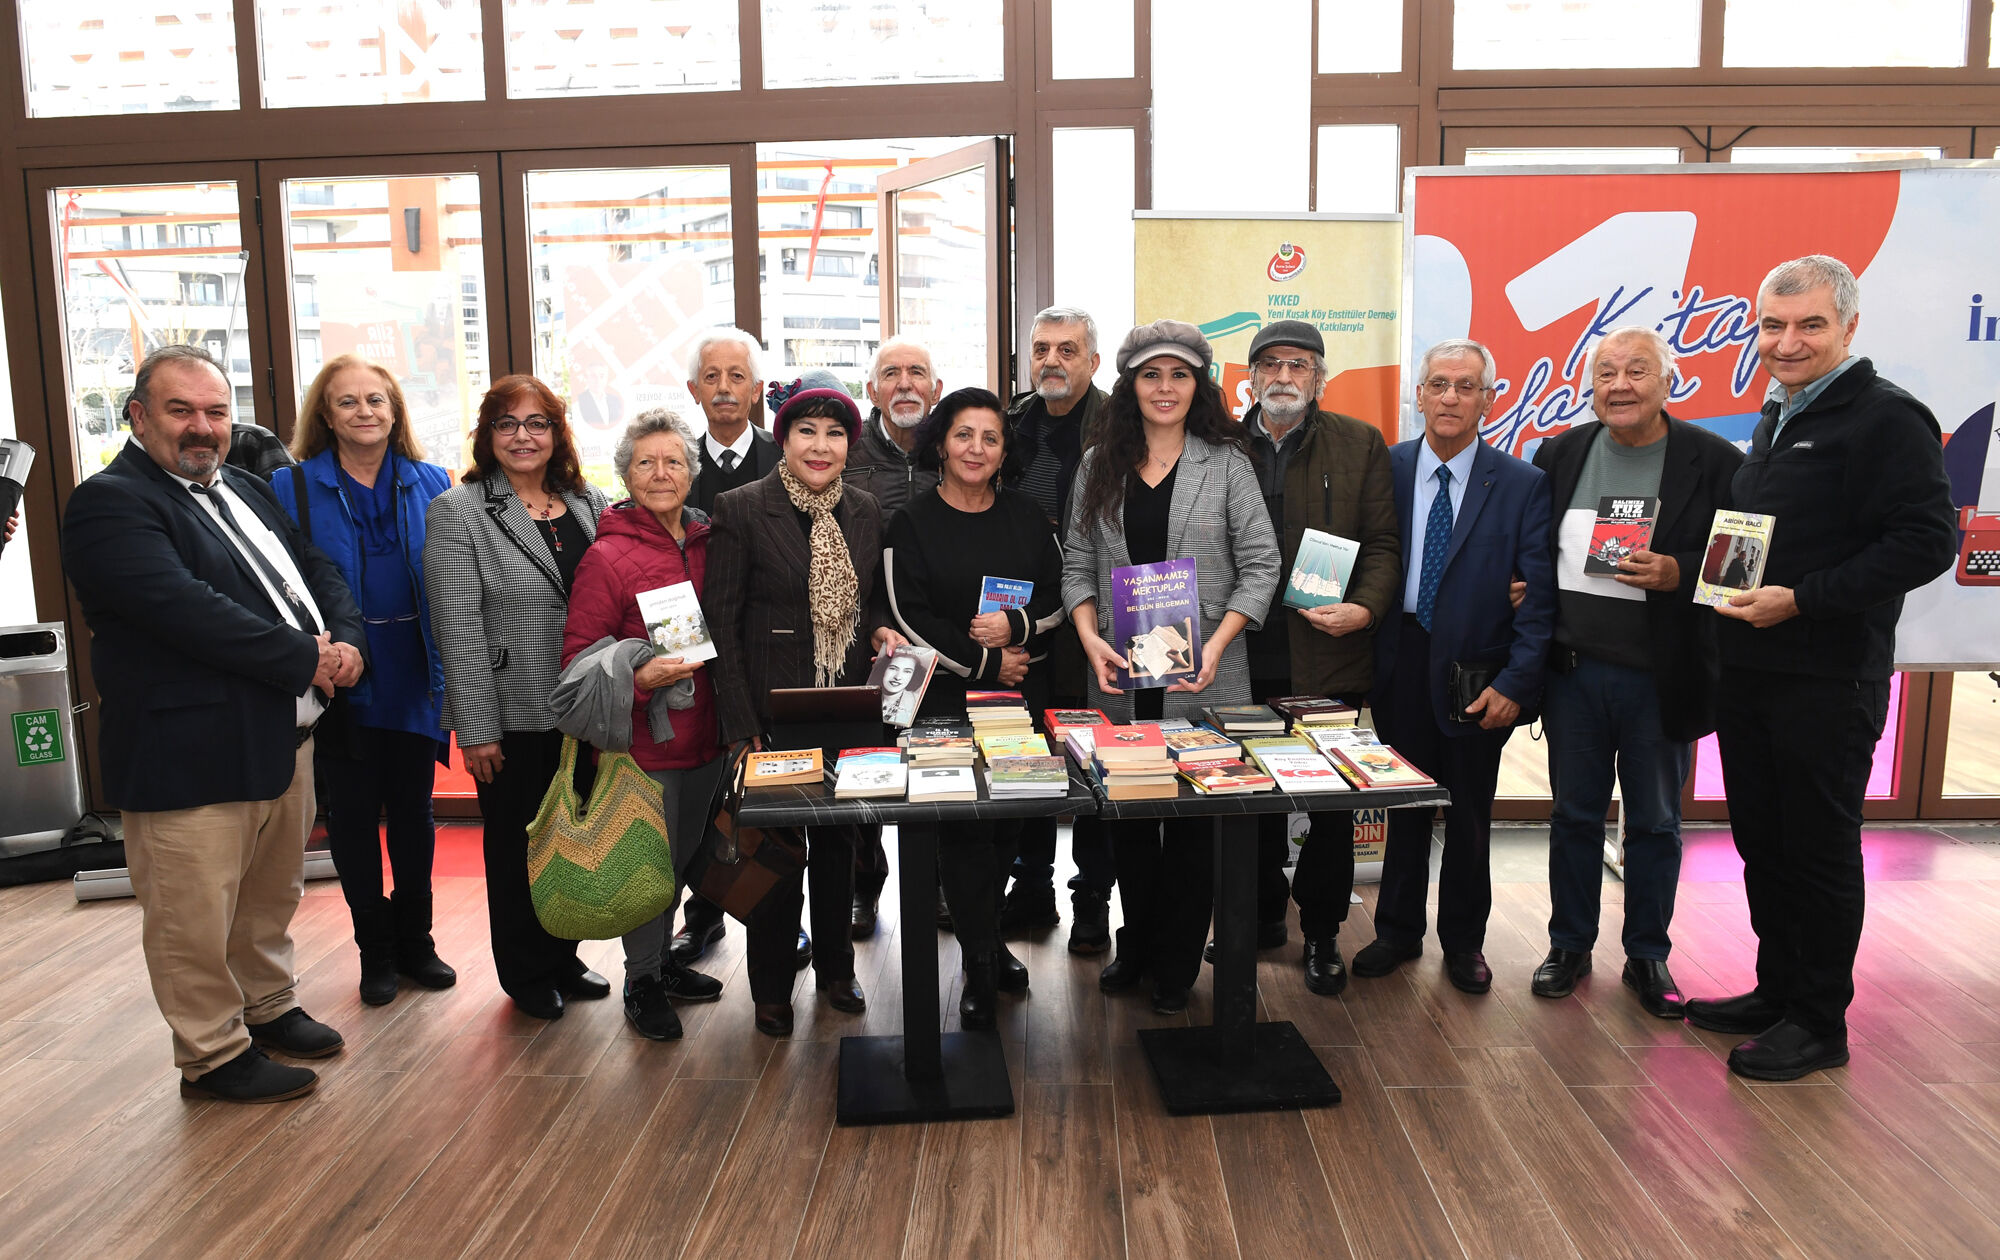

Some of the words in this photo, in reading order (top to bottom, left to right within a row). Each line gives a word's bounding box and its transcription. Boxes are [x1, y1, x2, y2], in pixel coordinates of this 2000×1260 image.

[1267, 294, 1300, 307] YKKED
[1267, 309, 1284, 319] Yeni
[1286, 309, 1309, 320] Kuşak
[1311, 309, 1326, 320] Köy
[1367, 309, 1398, 320] Derneği
[1319, 322, 1365, 333] Katkılarıyla
[1611, 504, 1645, 514] TUZ
[1123, 569, 1189, 586] YAŞANMAMIŞ
[1132, 581, 1186, 597] MEKTUPLAR
[1126, 602, 1154, 613] BELGÜN
[1155, 598, 1190, 610] BİLGEMAN
[26, 715, 47, 726] CAM
[29, 751, 53, 760] GLASS
[1352, 809, 1385, 825] KAN
[1352, 825, 1382, 841] DIN
